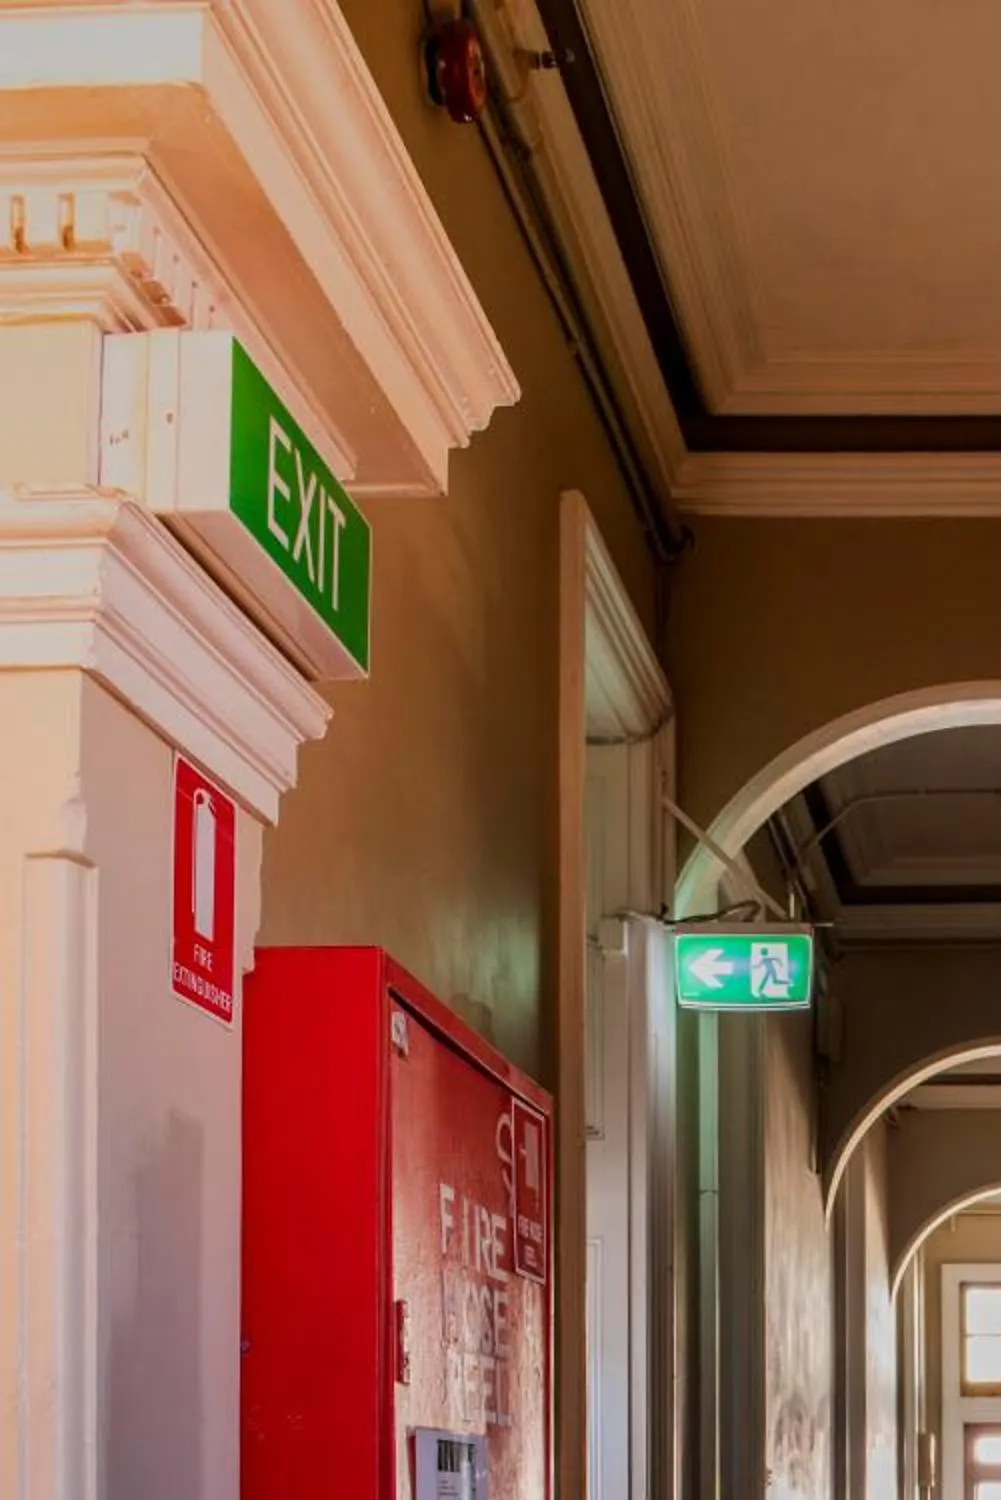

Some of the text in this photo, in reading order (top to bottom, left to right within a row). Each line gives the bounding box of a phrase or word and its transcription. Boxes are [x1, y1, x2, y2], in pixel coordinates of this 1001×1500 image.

[268, 414, 346, 612] EXIT
[172, 961, 232, 1013] EXTINGUISHER
[193, 943, 213, 973] FIRE
[440, 1183, 508, 1283] FIRE
[446, 1348, 514, 1427] REEL
